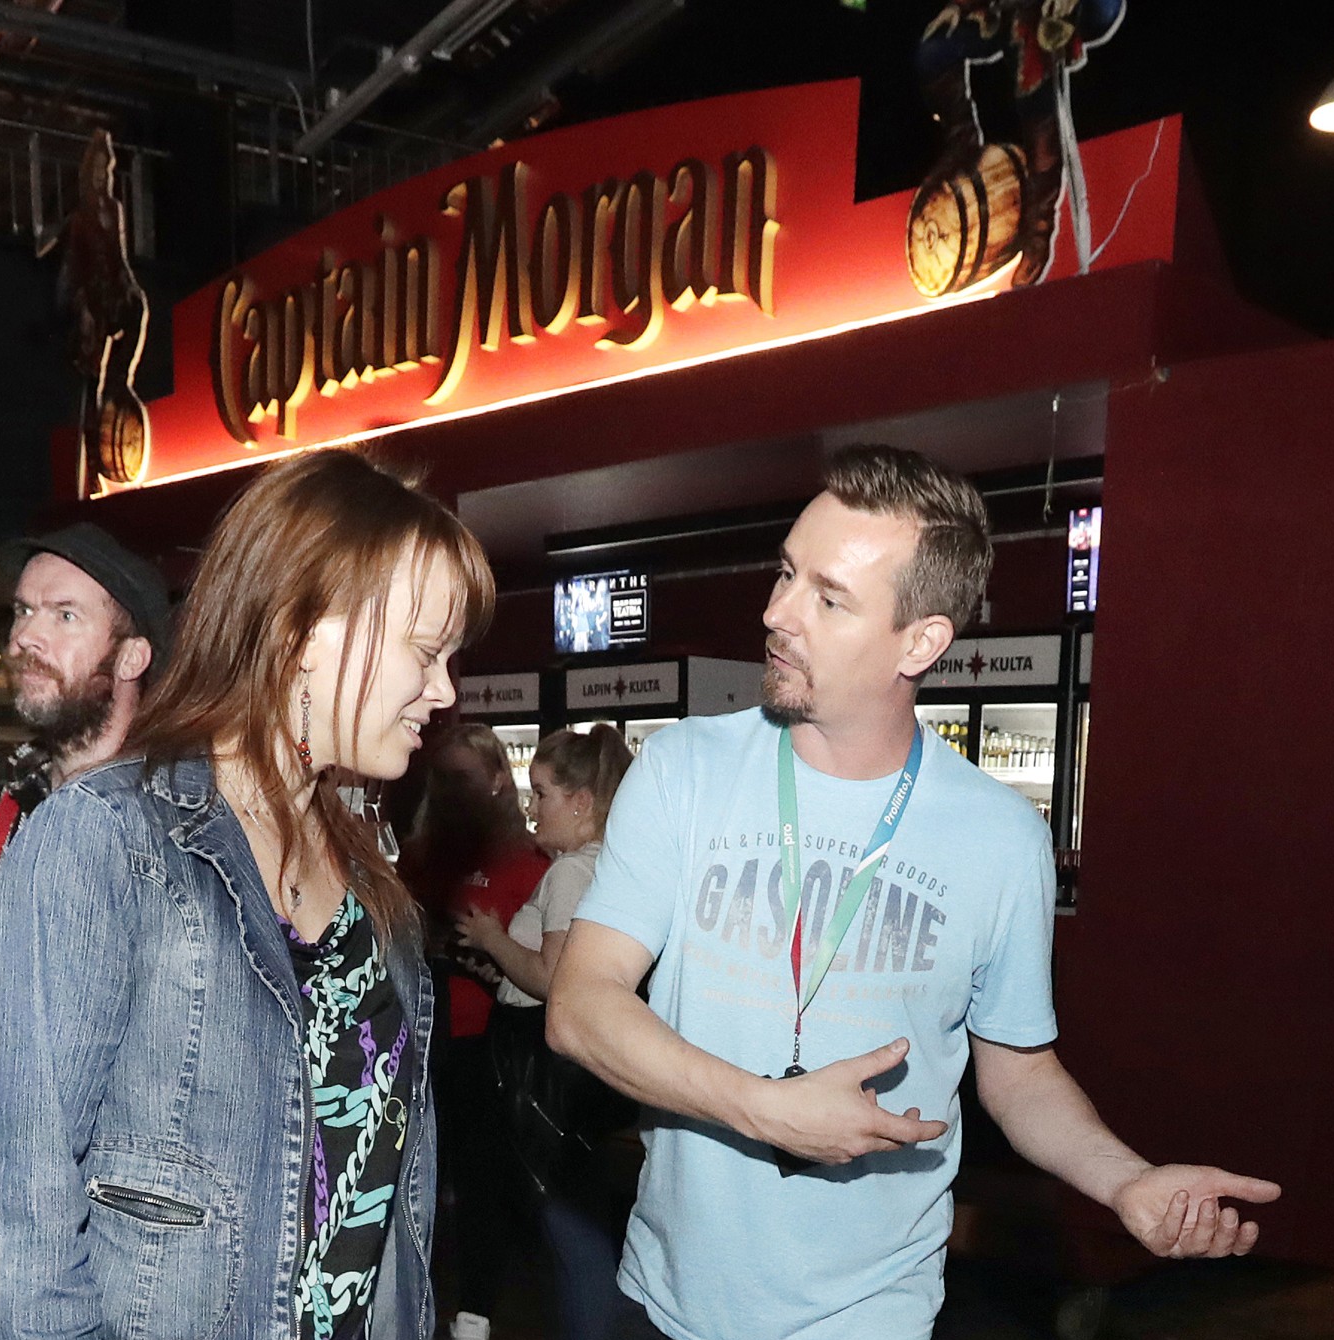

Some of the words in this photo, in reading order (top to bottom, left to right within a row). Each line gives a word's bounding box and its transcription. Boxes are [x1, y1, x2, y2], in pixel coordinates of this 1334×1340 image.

[209, 215, 440, 448] Captain
[424, 145, 780, 406] Morgan
[930, 659, 963, 674] APIN
[990, 655, 1033, 672] KULTA
[458, 690, 480, 702] APIN
[494, 688, 523, 702] KULTA
[582, 682, 611, 697] LAPIN
[629, 679, 660, 694] KULTA
[883, 771, 913, 825] Proliitto.fi
[784, 823, 794, 845] pro
[805, 834, 889, 869] SUPERR
[896, 861, 948, 897] GOODS
